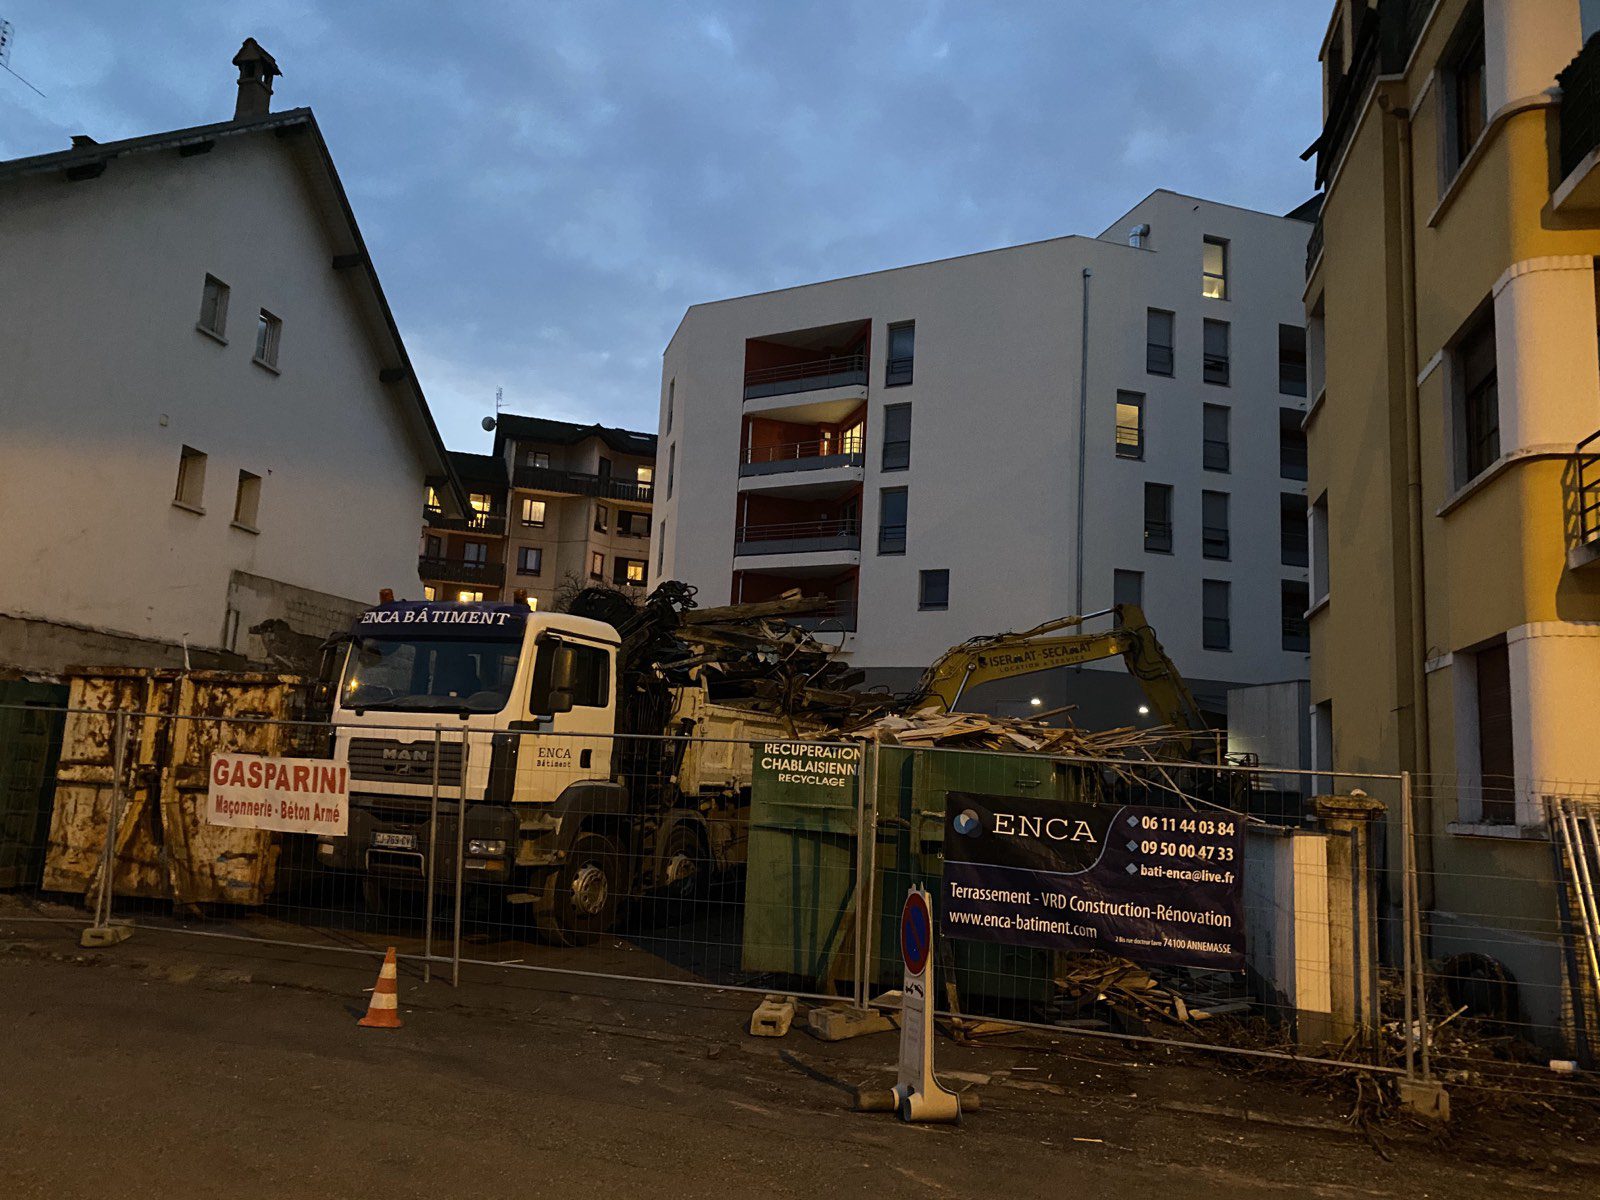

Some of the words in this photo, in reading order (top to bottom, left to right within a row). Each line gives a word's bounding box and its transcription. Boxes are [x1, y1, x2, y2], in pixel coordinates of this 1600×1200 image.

[361, 611, 400, 624] ENCA
[402, 607, 511, 625] BÂTIMENT
[383, 748, 428, 761] MAN
[538, 747, 571, 759] ENCA
[213, 758, 346, 794] GASPARINI
[761, 757, 860, 776] CHABLAISIENN
[778, 773, 845, 787] RECYCLAGE
[215, 794, 272, 819] Maçonnerie
[281, 800, 310, 821] Béton
[313, 802, 340, 823] Armé
[992, 813, 1098, 843] ENCA
[1141, 816, 1158, 830] 06
[1161, 817, 1176, 831] 11
[1180, 819, 1196, 833] 44
[1198, 821, 1214, 834] 03
[1218, 822, 1235, 836] 84
[1141, 840, 1157, 854] 09
[1160, 842, 1176, 857] 50
[1179, 844, 1195, 858] 00
[1198, 846, 1215, 859] 47
[1217, 847, 1234, 861] 33
[1140, 863, 1235, 884] bati-enca@live.fr
[950, 882, 1031, 905] Terrassement
[1041, 892, 1067, 909] VRD
[949, 911, 1097, 938] www.enca-batiment.com
[1163, 937, 1186, 950] 74100
[1187, 940, 1232, 954] ANNEMASSE
